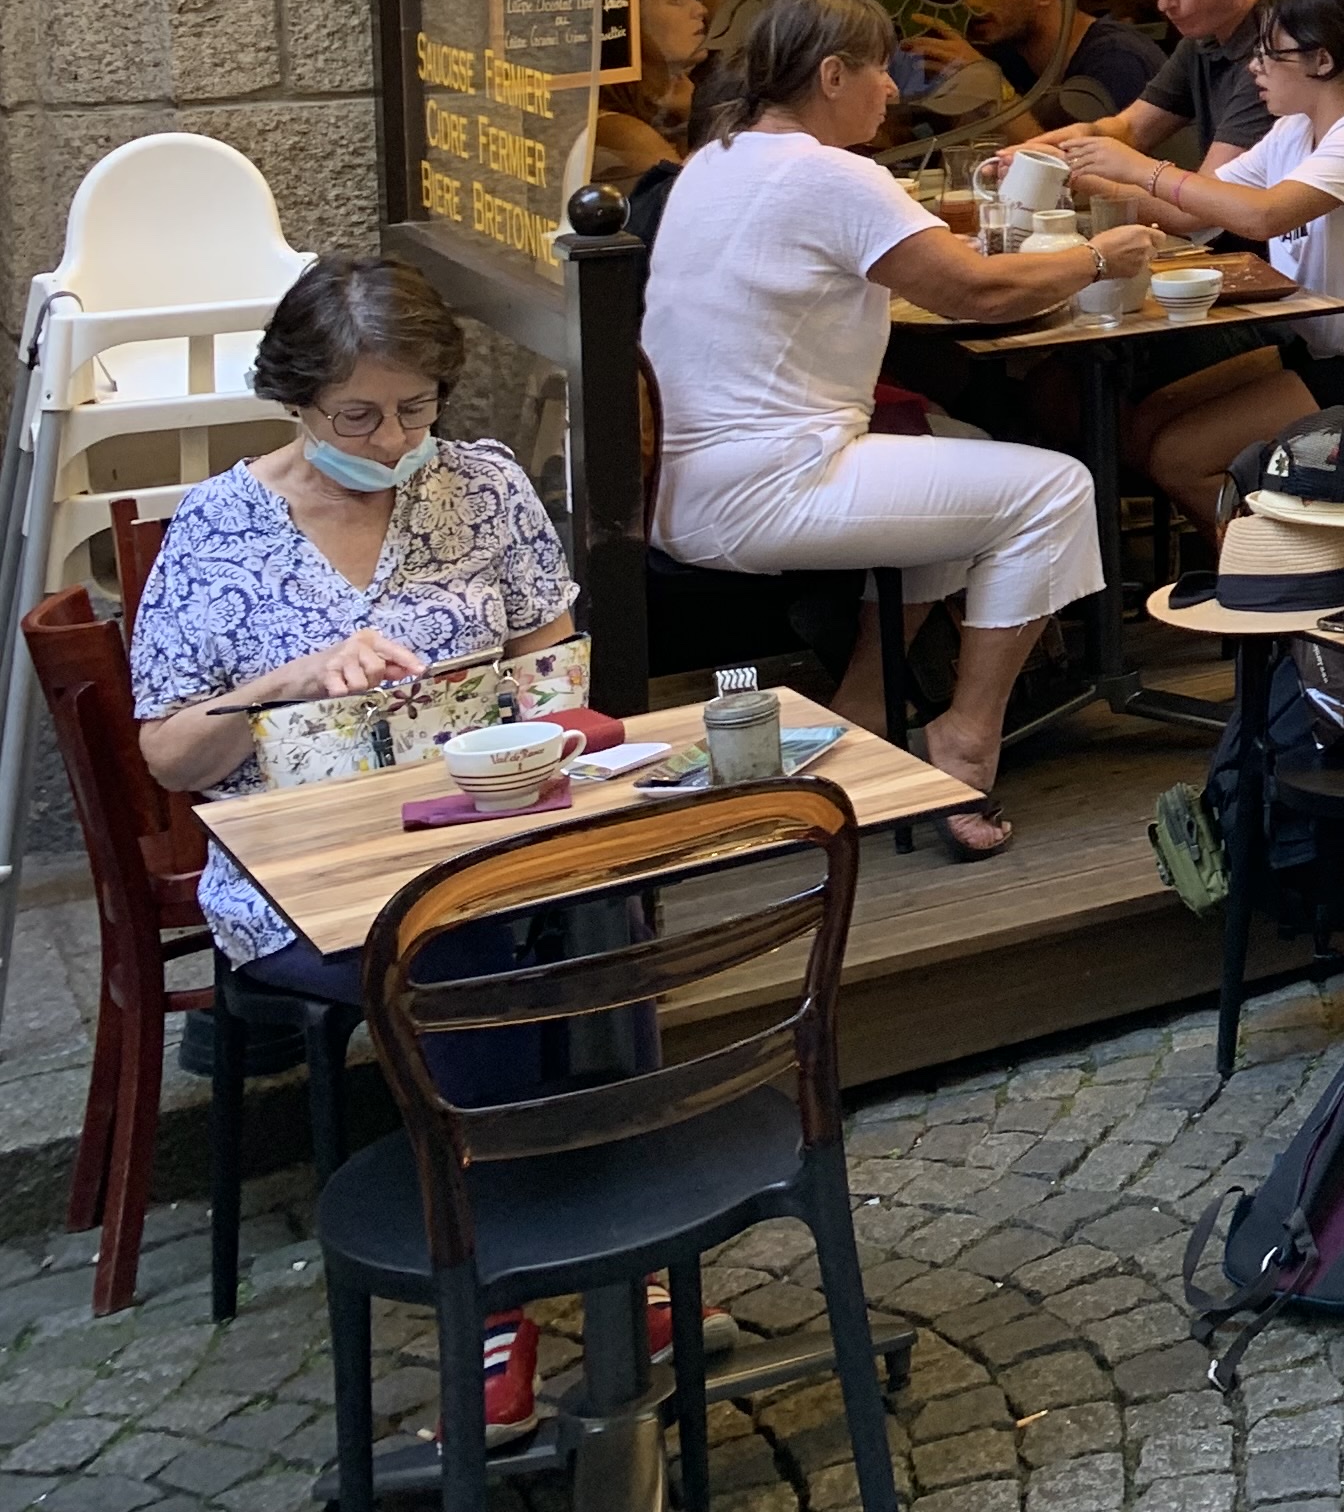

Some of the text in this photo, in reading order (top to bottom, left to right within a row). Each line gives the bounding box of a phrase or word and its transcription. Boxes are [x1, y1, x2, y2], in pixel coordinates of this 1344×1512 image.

[416, 32, 555, 120] SAUCISSE FERMIERE
[425, 98, 547, 189] CIDRE FERMIER
[420, 159, 561, 268] BIERE BRETONNE
[490, 751, 511, 765] Val
